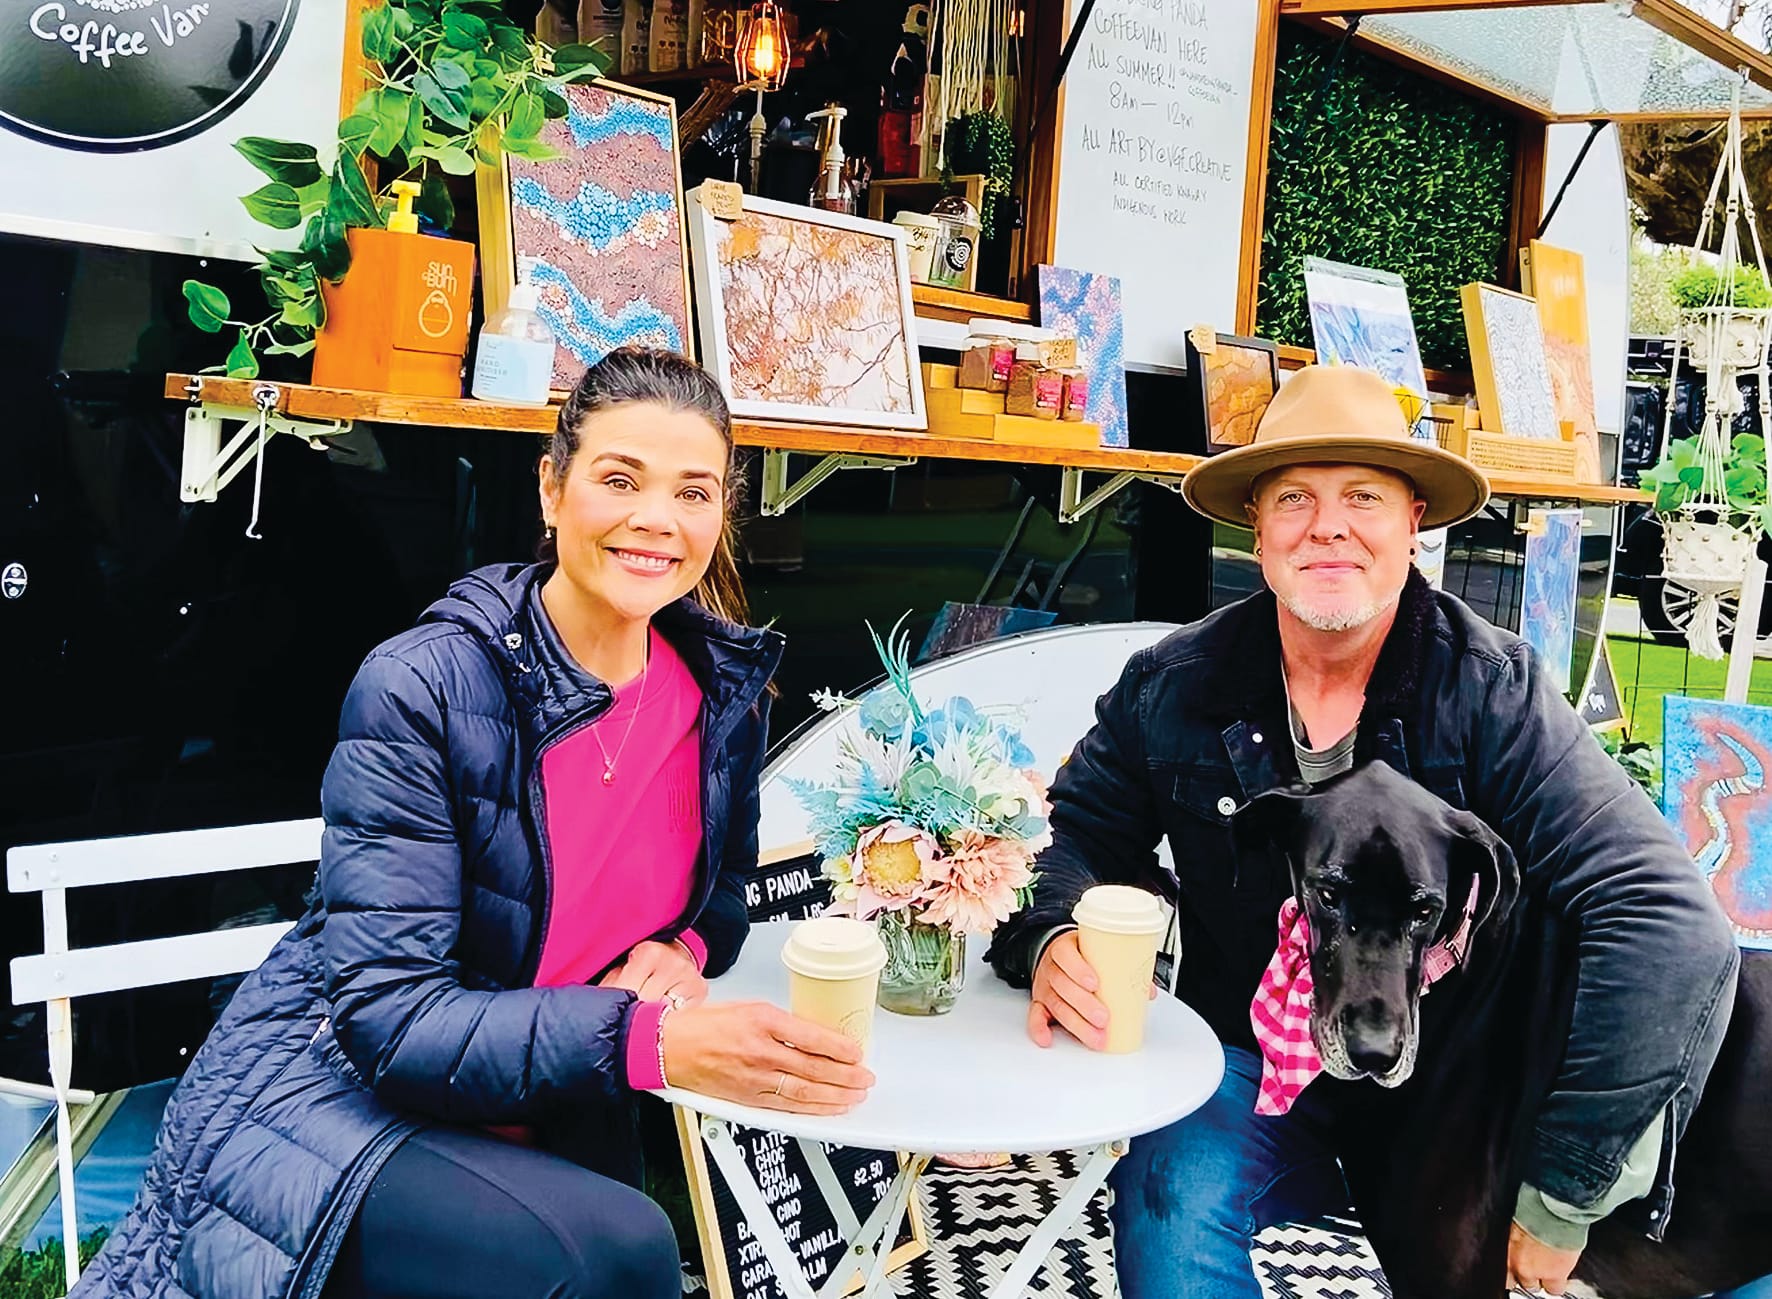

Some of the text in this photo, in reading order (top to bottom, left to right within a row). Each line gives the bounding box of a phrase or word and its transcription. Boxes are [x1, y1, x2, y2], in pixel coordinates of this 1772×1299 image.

[29, 2, 149, 69] Coffee
[1141, 23, 1168, 54] VAN
[1178, 36, 1208, 65] HERE
[1087, 42, 1110, 71] ALL
[1081, 123, 1101, 151] ALL
[1108, 127, 1134, 157] ART
[765, 867, 814, 903] PANDA
[751, 1131, 790, 1157] LATTE
[755, 1145, 787, 1174] CHOC
[853, 1159, 884, 1188] $2.50
[759, 1162, 788, 1189] CHAI
[761, 1172, 803, 1205] MOCHA
[776, 1197, 802, 1223] CINO
